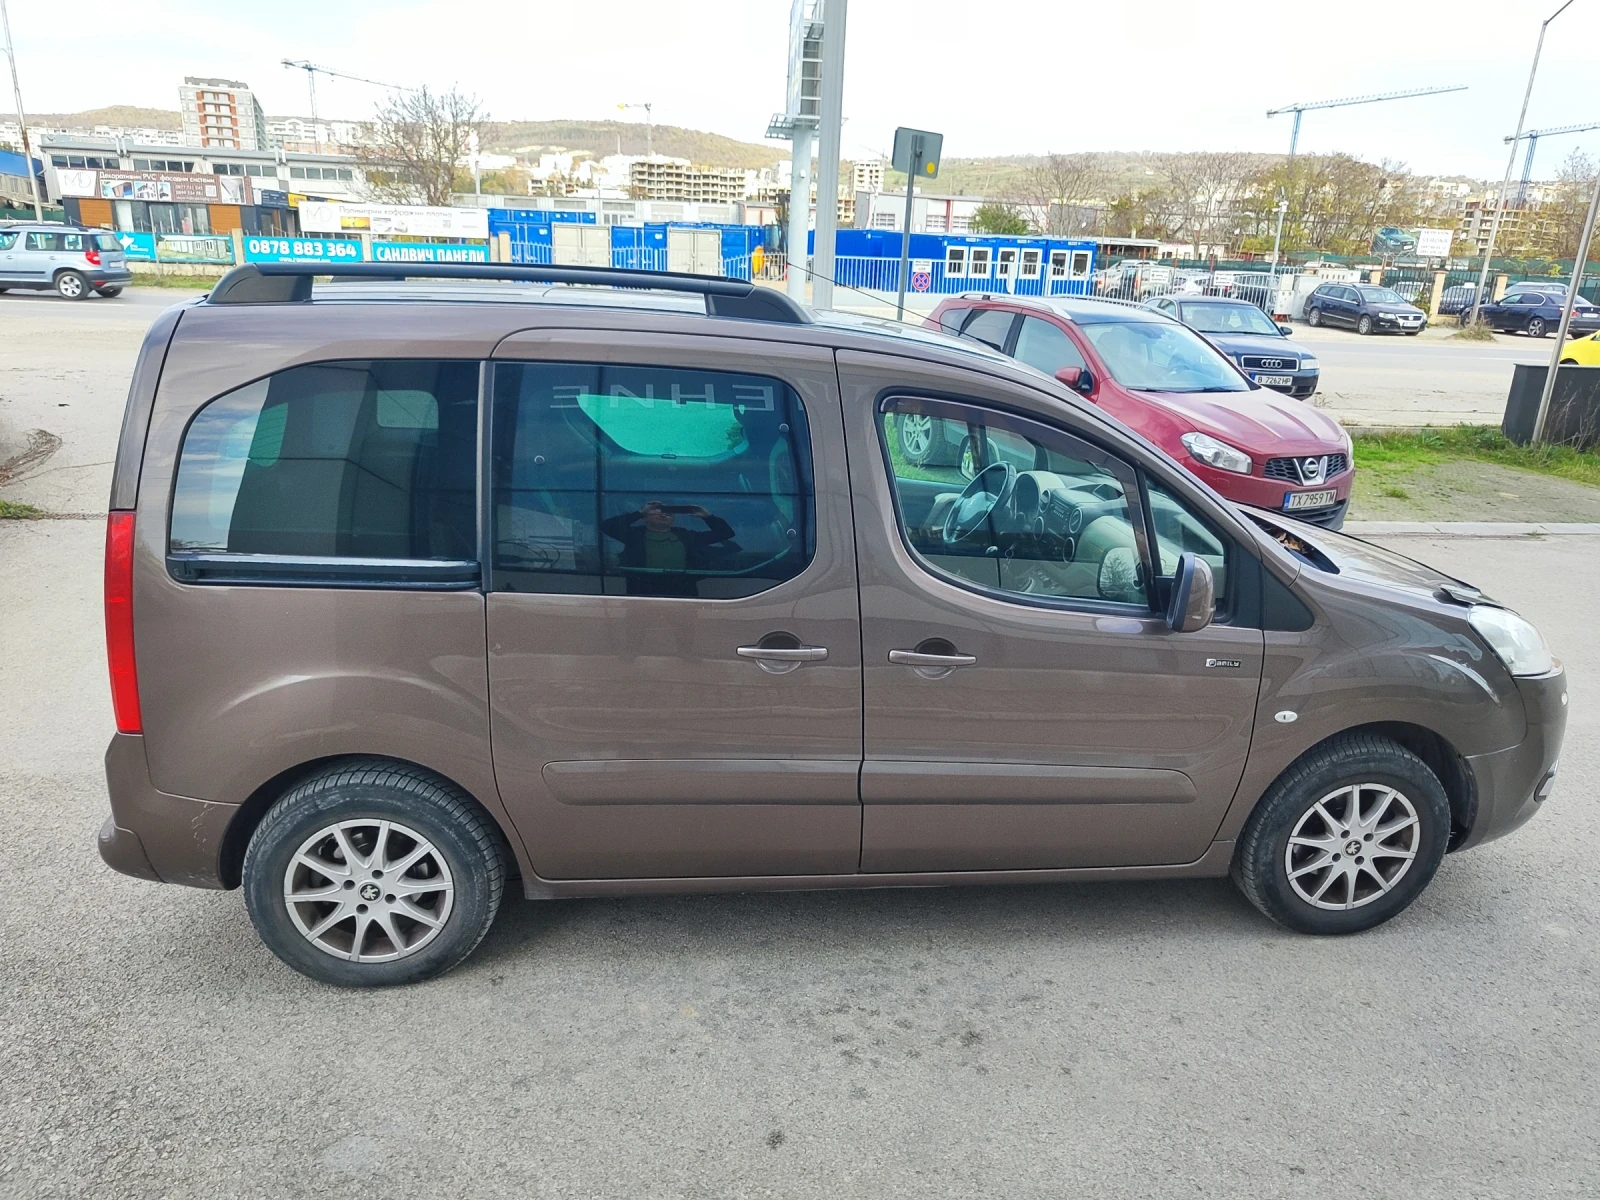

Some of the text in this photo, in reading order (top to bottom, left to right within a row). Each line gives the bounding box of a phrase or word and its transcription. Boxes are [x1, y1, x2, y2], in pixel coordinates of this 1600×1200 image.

[142, 173, 157, 181] PVC
[249, 239, 357, 258] 0878 883 364
[376, 246, 485, 262] САНДВИЧ ПАНЕЛИ
[1291, 495, 1303, 507] TX
[1303, 492, 1324, 506] 7959
